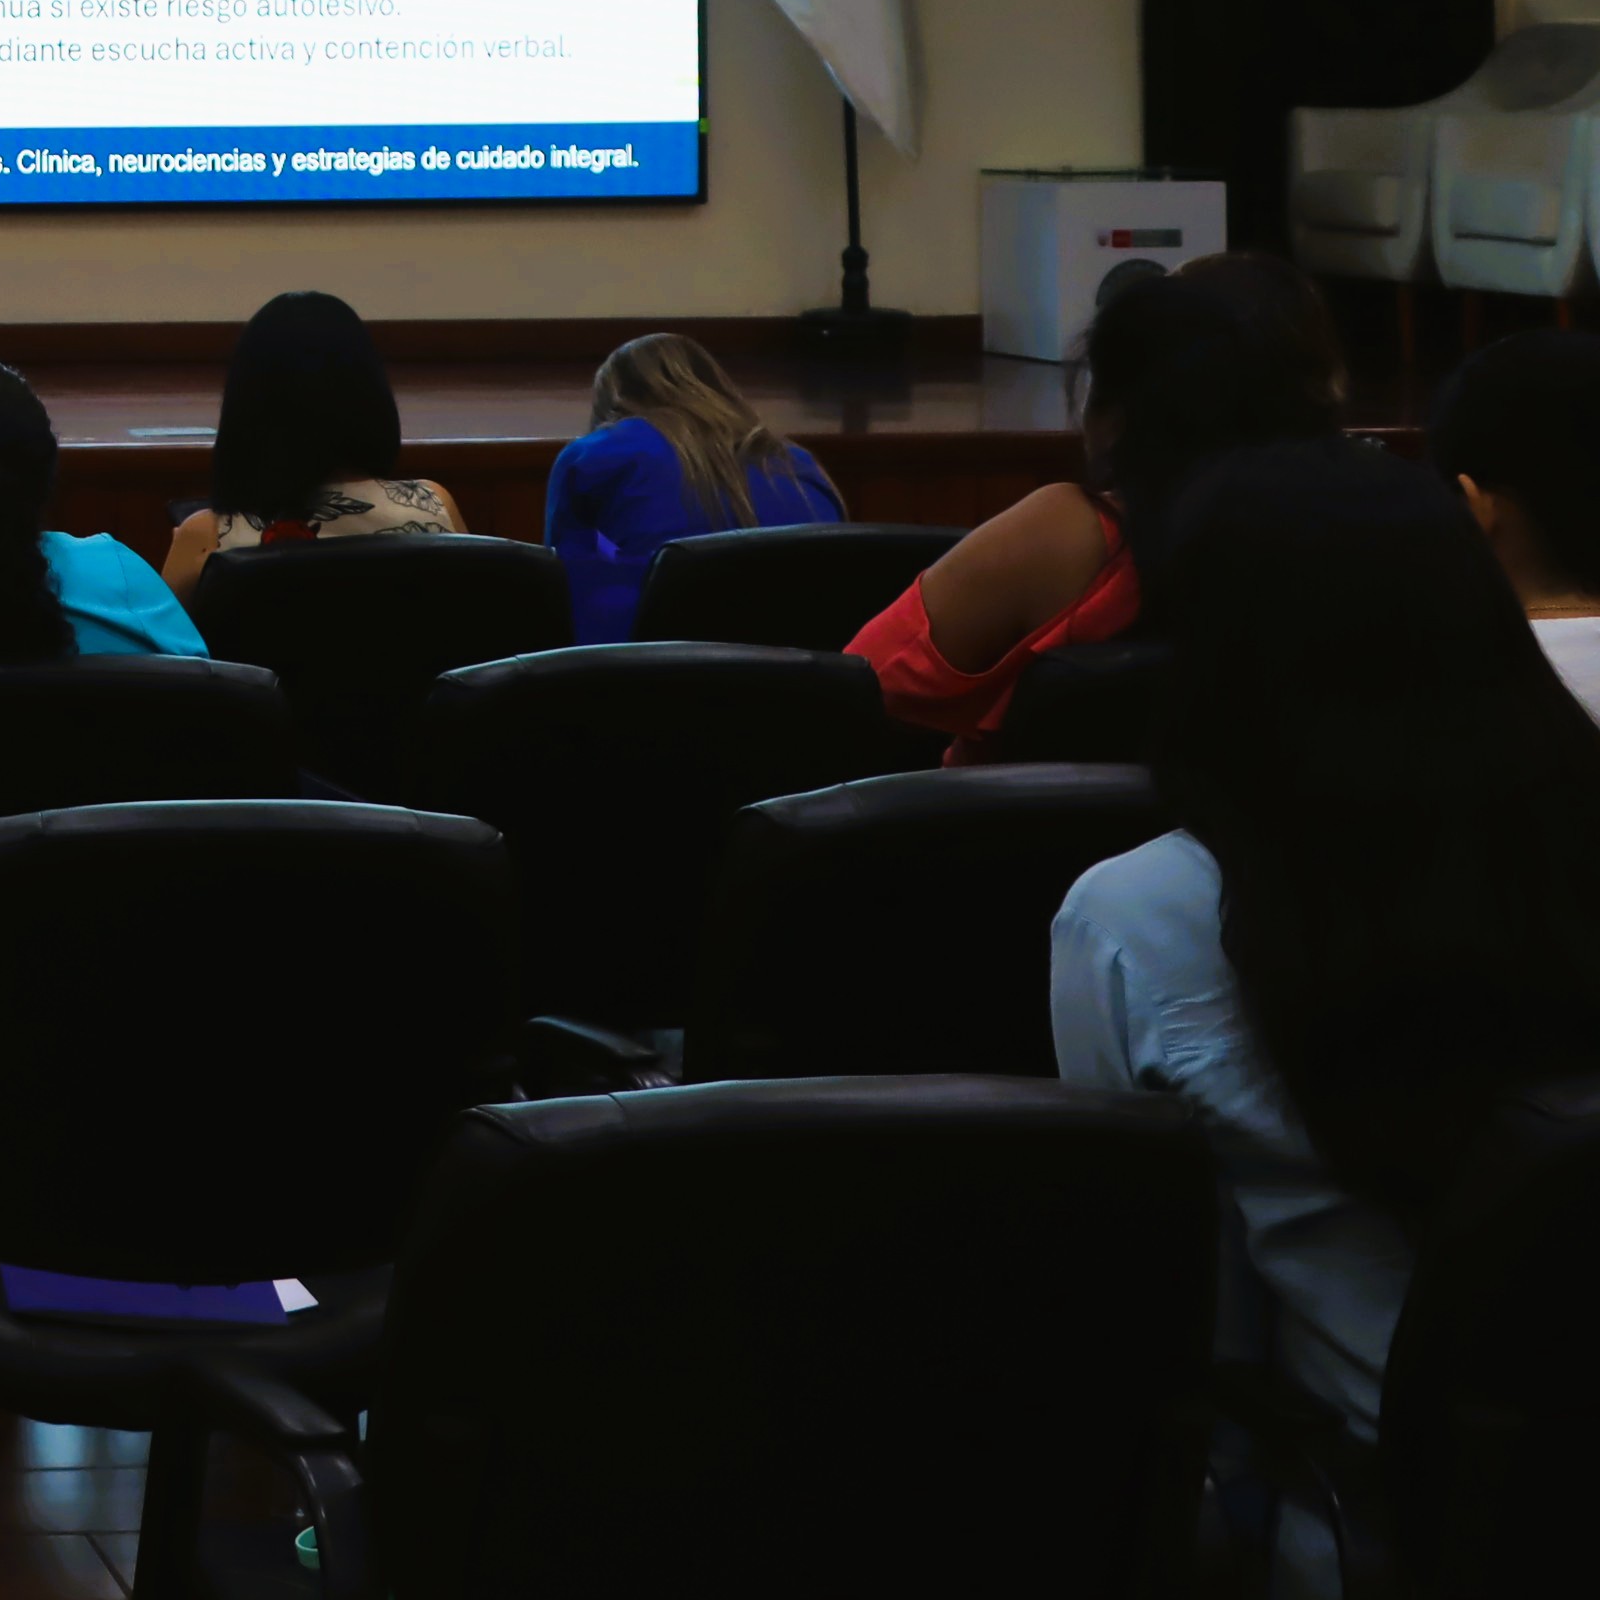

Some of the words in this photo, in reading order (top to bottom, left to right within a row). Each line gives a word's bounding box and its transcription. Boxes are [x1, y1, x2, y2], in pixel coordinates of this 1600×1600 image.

[16, 148, 103, 177] Clínica,
[108, 147, 267, 174] neurociencias
[271, 152, 287, 177] y
[291, 145, 416, 176] estrategias
[420, 145, 452, 170] de
[455, 144, 546, 170] cuidado
[550, 143, 640, 174] integral.
